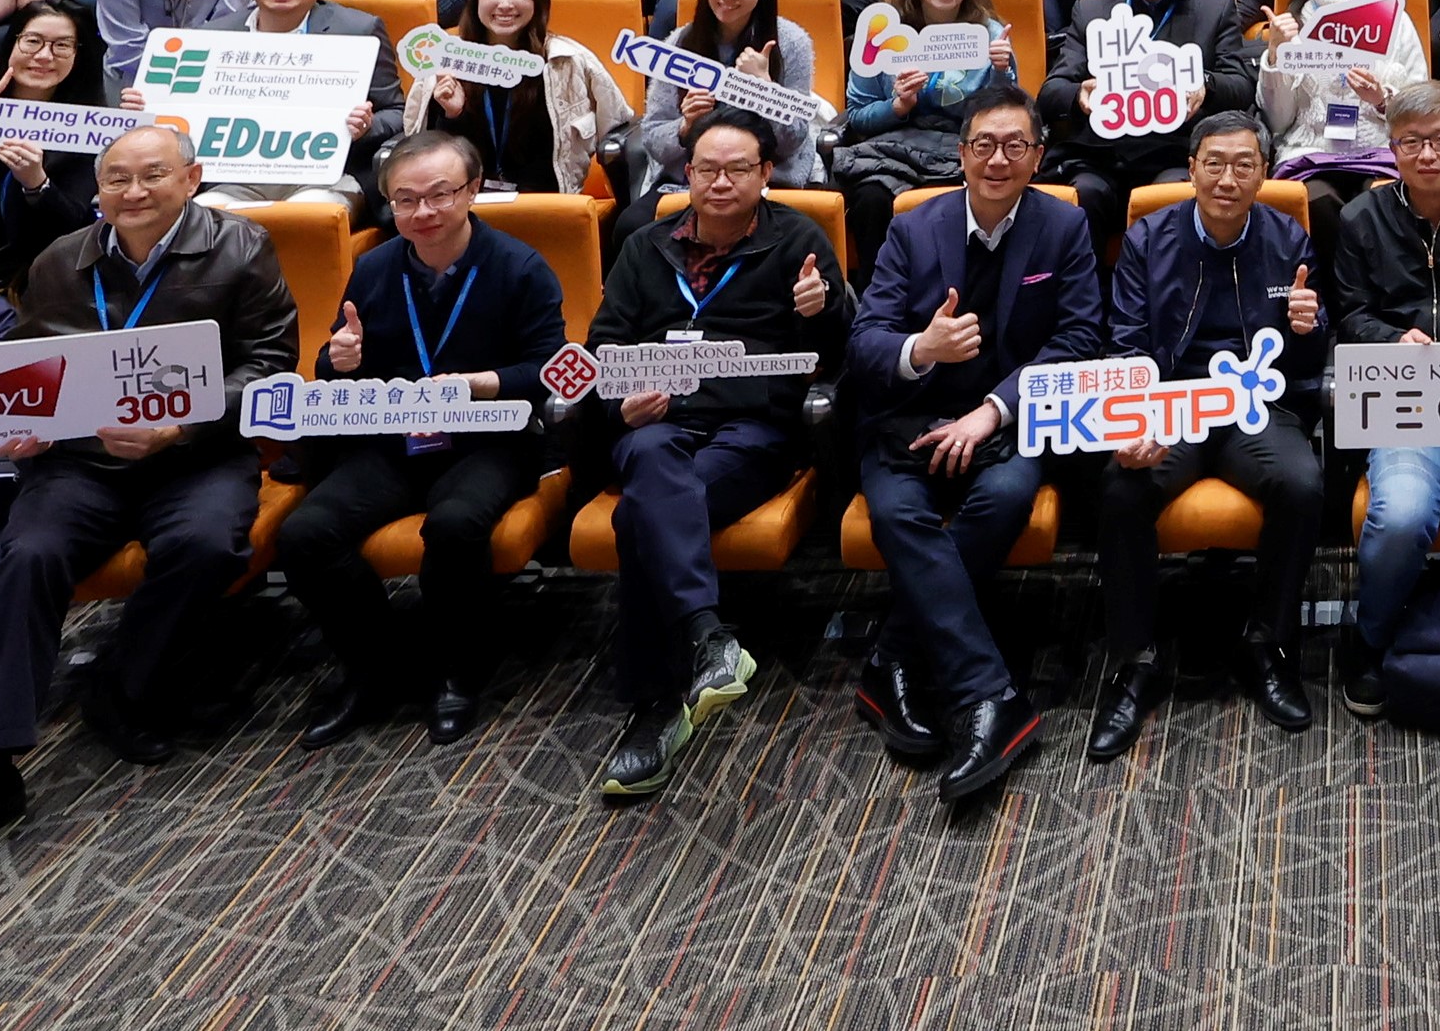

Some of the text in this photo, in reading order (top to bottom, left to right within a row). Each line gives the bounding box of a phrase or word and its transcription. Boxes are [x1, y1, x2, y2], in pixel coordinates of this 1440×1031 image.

[923, 42, 978, 52] INNOVATIVE
[930, 33, 966, 43] CENTRE
[1098, 23, 1148, 59] HK
[1317, 22, 1382, 49] CityU
[219, 50, 315, 66] 香港教育大學
[440, 56, 515, 81] 事業策劃中心
[444, 42, 537, 70] Career Centre
[615, 34, 722, 92] KTEO
[891, 51, 978, 64] SERVICE-LEARNING
[1283, 51, 1344, 61] 香港城市大學
[1283, 63, 1297, 71] City
[1327, 62, 1335, 70] of
[1335, 62, 1353, 70] Hong
[1353, 62, 1371, 70] Kong
[213, 71, 358, 88] The Education University
[1099, 53, 1195, 92] TECH
[208, 85, 291, 100] of Hong Kong
[723, 80, 813, 118] Entrepreneurship Office
[727, 71, 818, 110] Knowledge Transfer and
[22, 105, 78, 127] Hong
[83, 111, 138, 131] Kong
[1100, 87, 1179, 131] 300
[196, 116, 339, 161] EDuce
[112, 343, 162, 372] HK
[600, 345, 739, 364] THE HONG KONG
[114, 364, 208, 396] TECH
[600, 358, 813, 380] POLYTECHNIC UNIVERSITY
[1027, 365, 1151, 398] 香港科技園
[1348, 363, 1417, 382] HONG
[303, 386, 460, 407] 香港浸會大學
[599, 378, 694, 396] 香港理工大學
[116, 389, 192, 425] 300
[301, 409, 520, 426] HONG KONG BAPTIST UNIVERSITY
[1027, 386, 1235, 449] HKSTP
[9, 426, 33, 437] Kong
